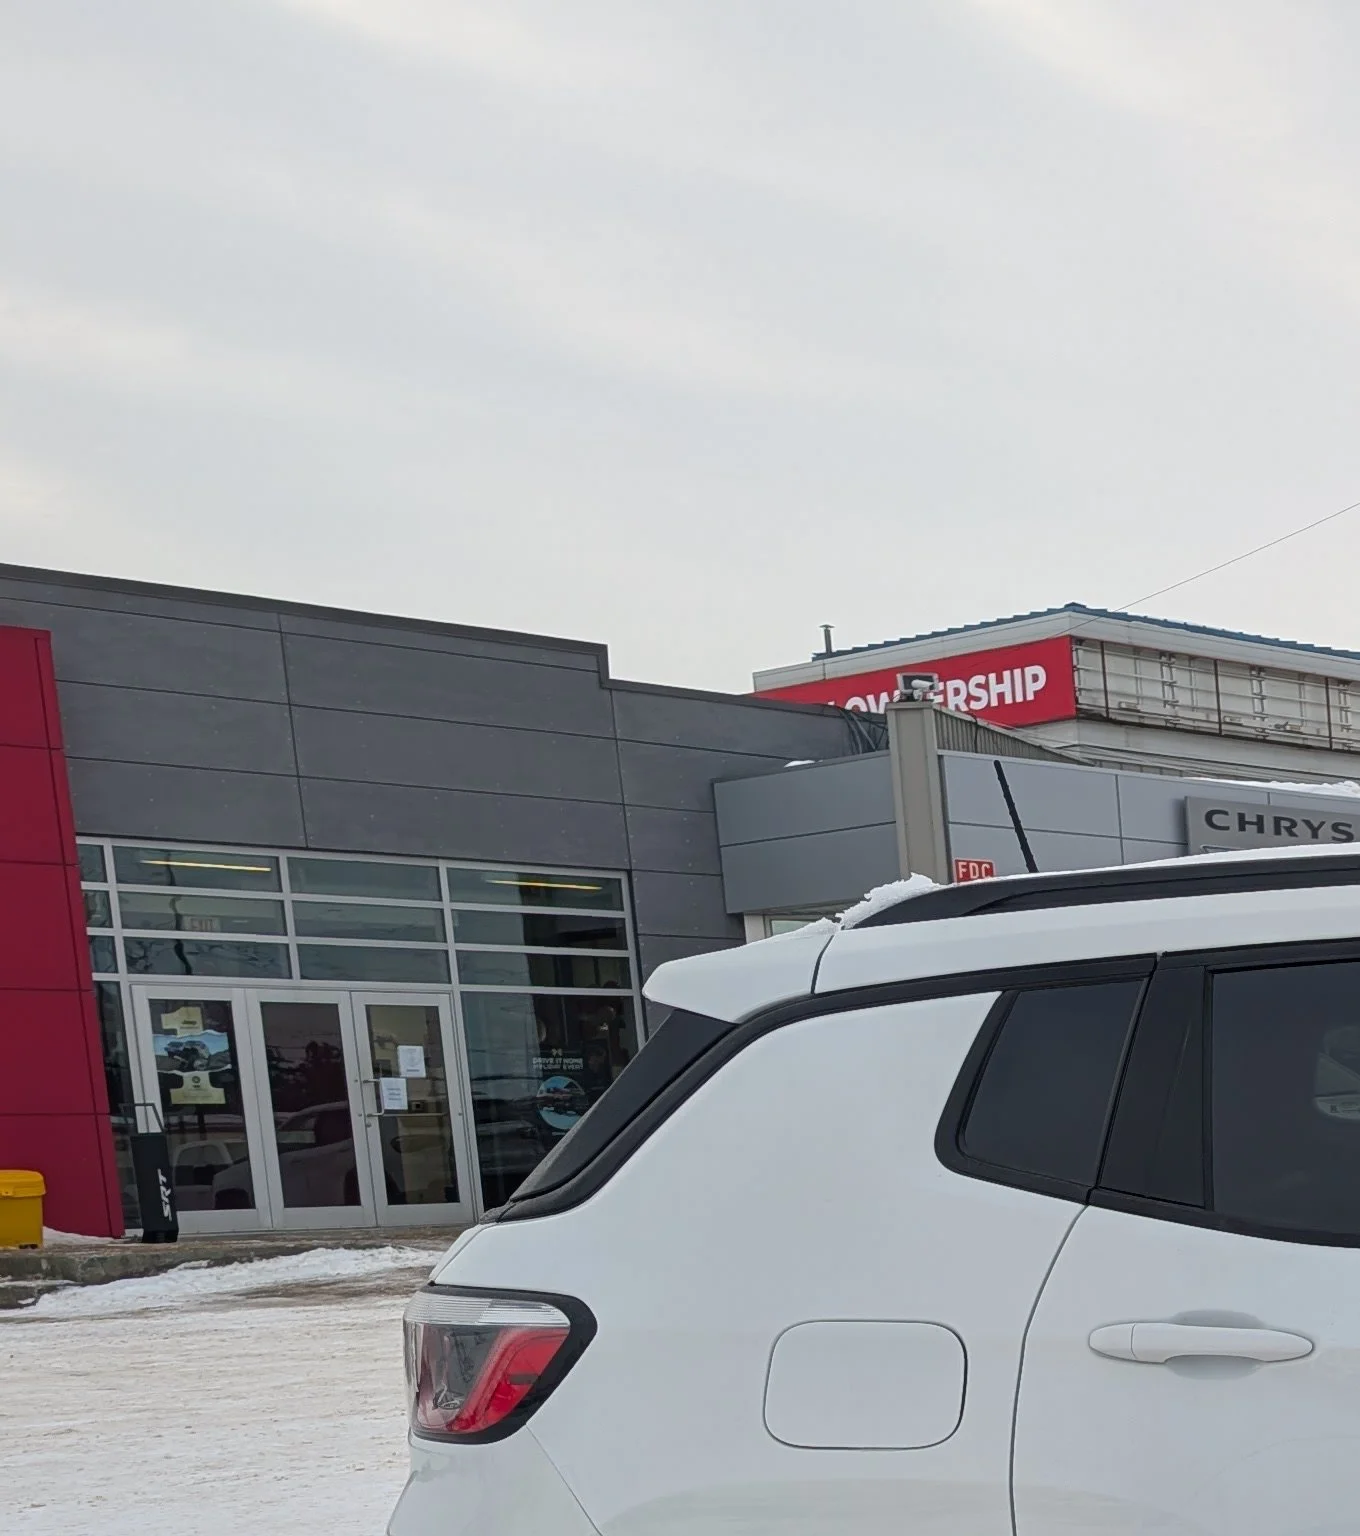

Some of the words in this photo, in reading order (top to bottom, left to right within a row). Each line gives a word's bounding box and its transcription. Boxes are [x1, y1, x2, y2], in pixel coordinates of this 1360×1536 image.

[844, 664, 1047, 714] OWERSHIP
[957, 861, 991, 879] FDC
[156, 1168, 172, 1222] SRT
